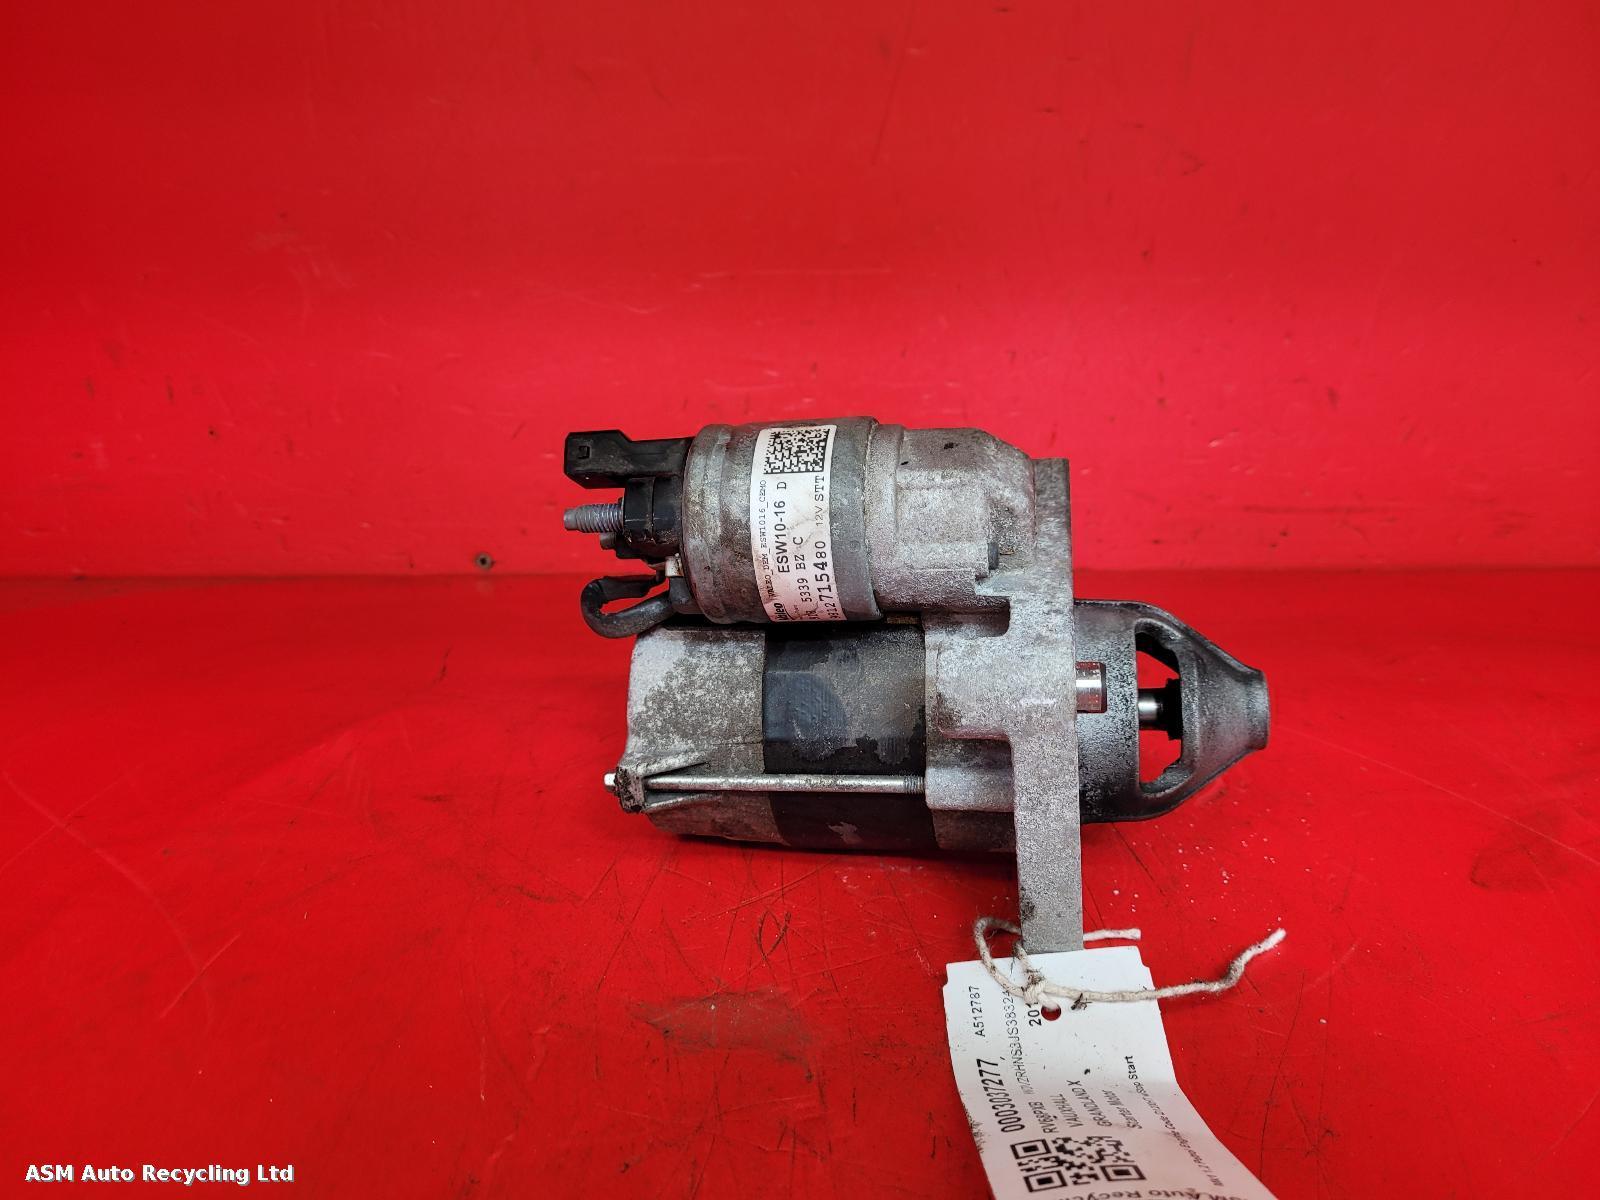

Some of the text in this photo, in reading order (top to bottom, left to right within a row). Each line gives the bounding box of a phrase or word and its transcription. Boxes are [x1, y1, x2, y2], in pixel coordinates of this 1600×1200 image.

[815, 476, 825, 501] STT
[774, 481, 790, 573] ESW10-16 D
[815, 506, 823, 526] 12V
[793, 536, 804, 546] C
[794, 554, 806, 570] BZ
[797, 578, 812, 602] 5339
[1026, 1001, 1042, 1026] 201
[968, 986, 1025, 1133] 0003037277 A512787
[1125, 1055, 1138, 1080] Start
[1050, 1093, 1083, 1127] VAUXHALL
[1072, 1088, 1112, 1126] GRANDLAND
[1102, 1089, 1142, 1129] Starter Motor
